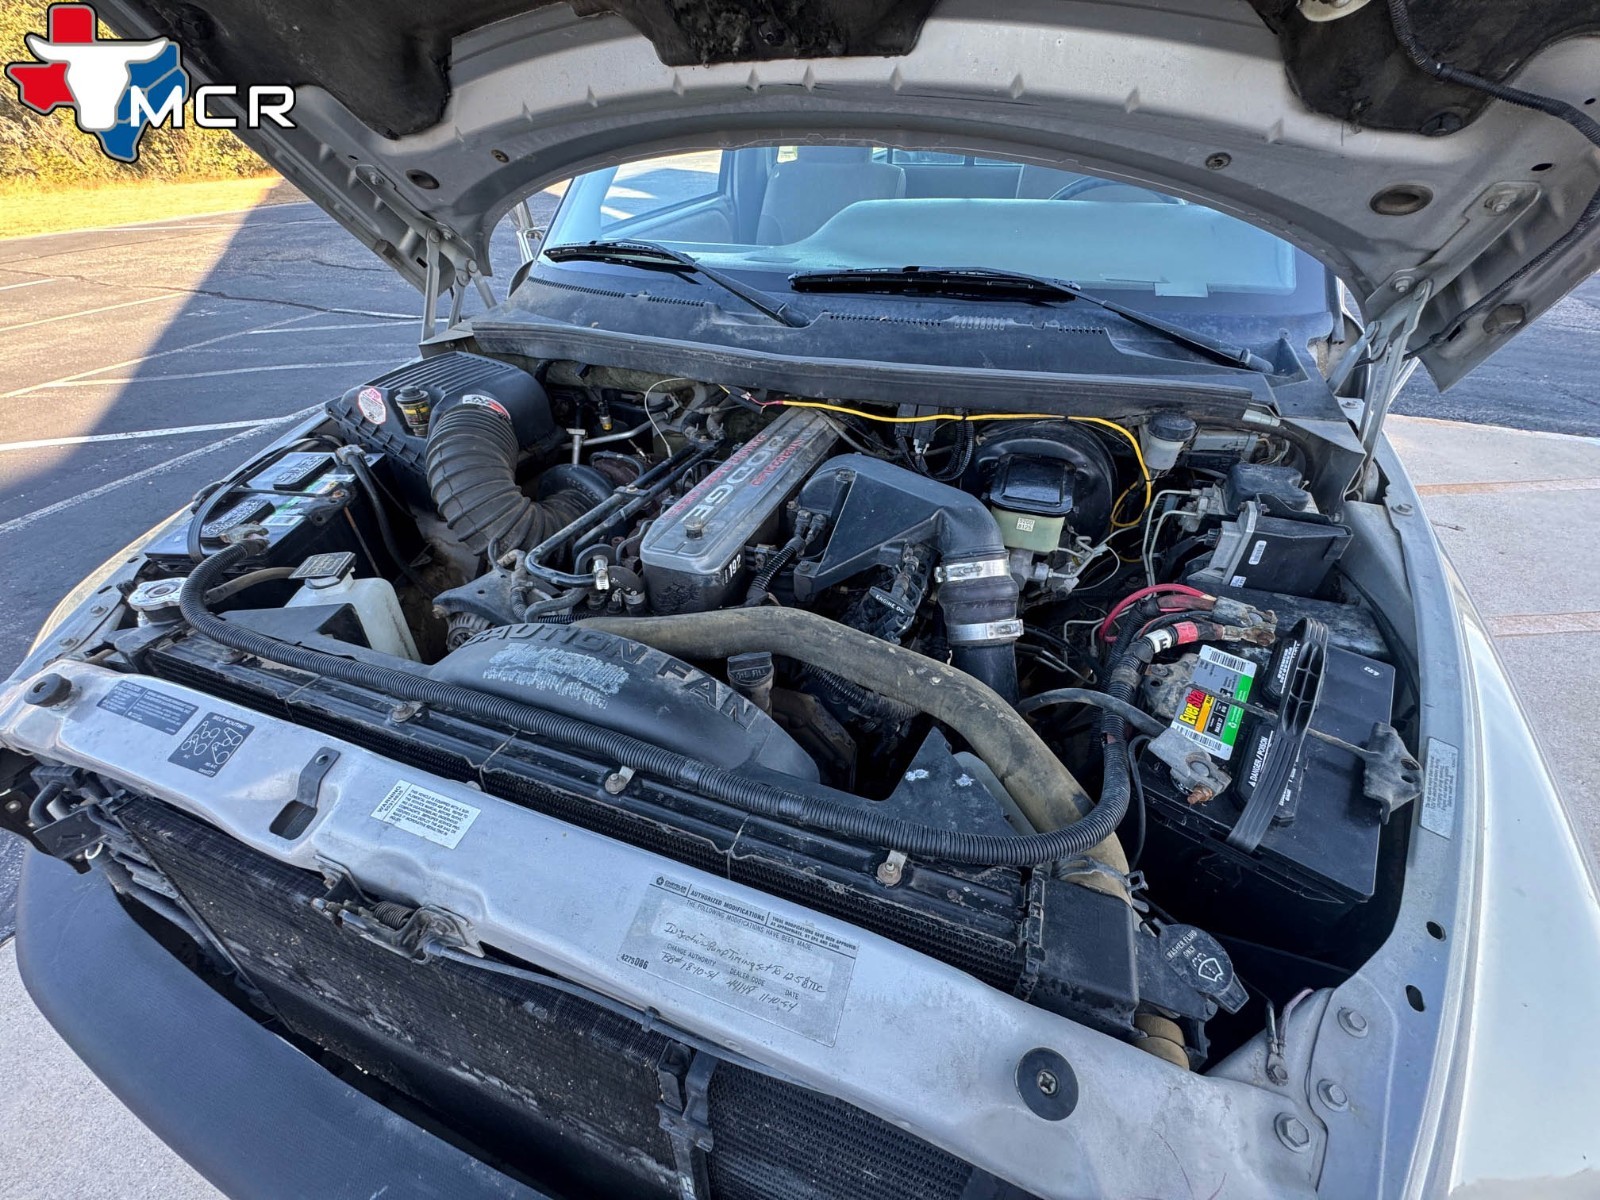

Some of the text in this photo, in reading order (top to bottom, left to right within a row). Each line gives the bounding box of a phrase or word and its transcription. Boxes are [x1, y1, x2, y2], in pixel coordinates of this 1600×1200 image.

[681, 435, 788, 520] DODGE
[461, 621, 759, 730] CAUTION FAN
[377, 786, 402, 813] WARNING
[690, 890, 765, 921] AUTHORIZED MODIFICATIONS
[686, 900, 697, 908] THE
[697, 903, 725, 919] FOLLOWING
[725, 914, 764, 933] MODIFICATIONS
[765, 928, 781, 938] HAVE
[781, 933, 795, 944] BEEN
[667, 943, 716, 966] CHANGE AUTHORITY
[1182, 945, 1196, 958] ONLY
[729, 968, 765, 986] DEALER CODE
[785, 989, 799, 1000] DATE
